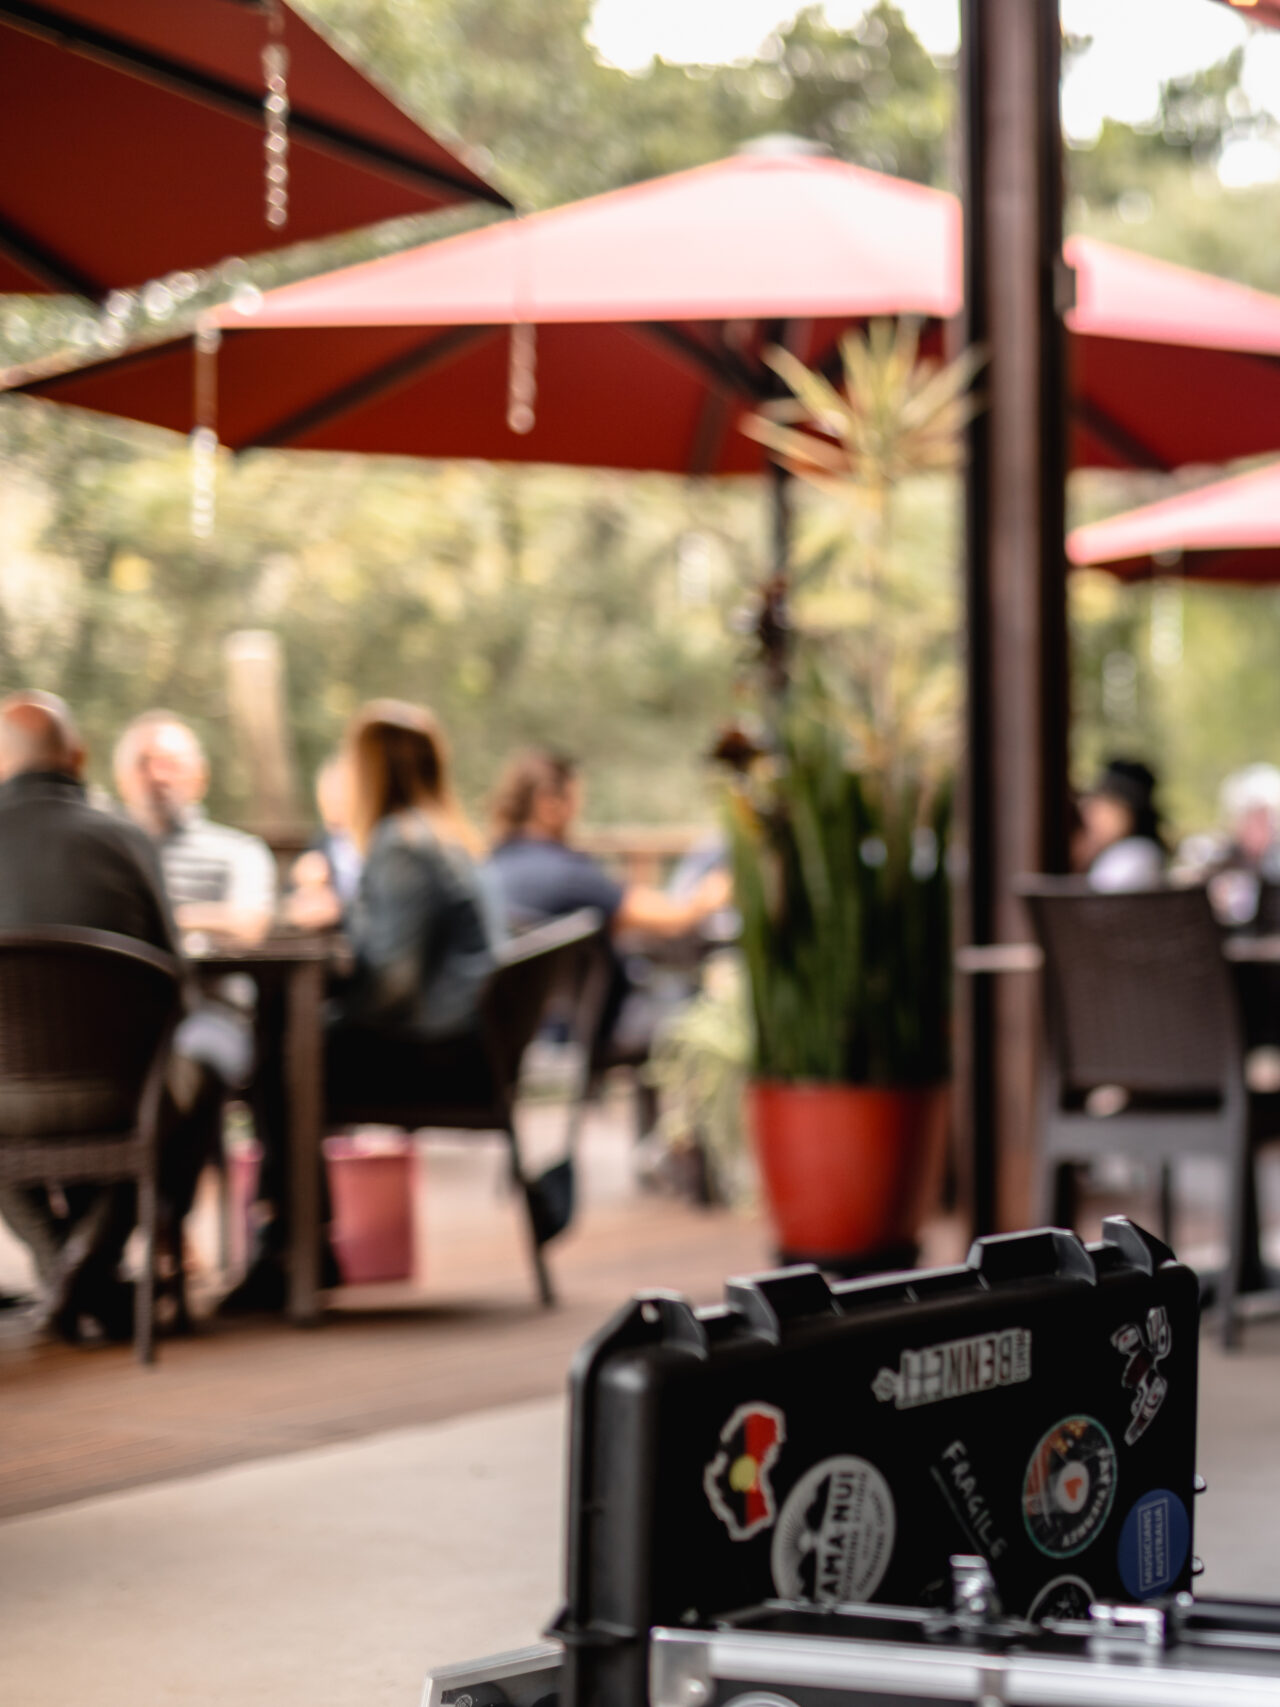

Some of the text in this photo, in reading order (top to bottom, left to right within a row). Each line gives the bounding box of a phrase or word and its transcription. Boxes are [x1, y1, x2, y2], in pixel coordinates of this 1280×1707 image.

[941, 1439, 1009, 1560] FRAGILE
[1142, 1509, 1153, 1585] MUSICIANS
[1154, 1506, 1164, 1578] AUSTRALIA
